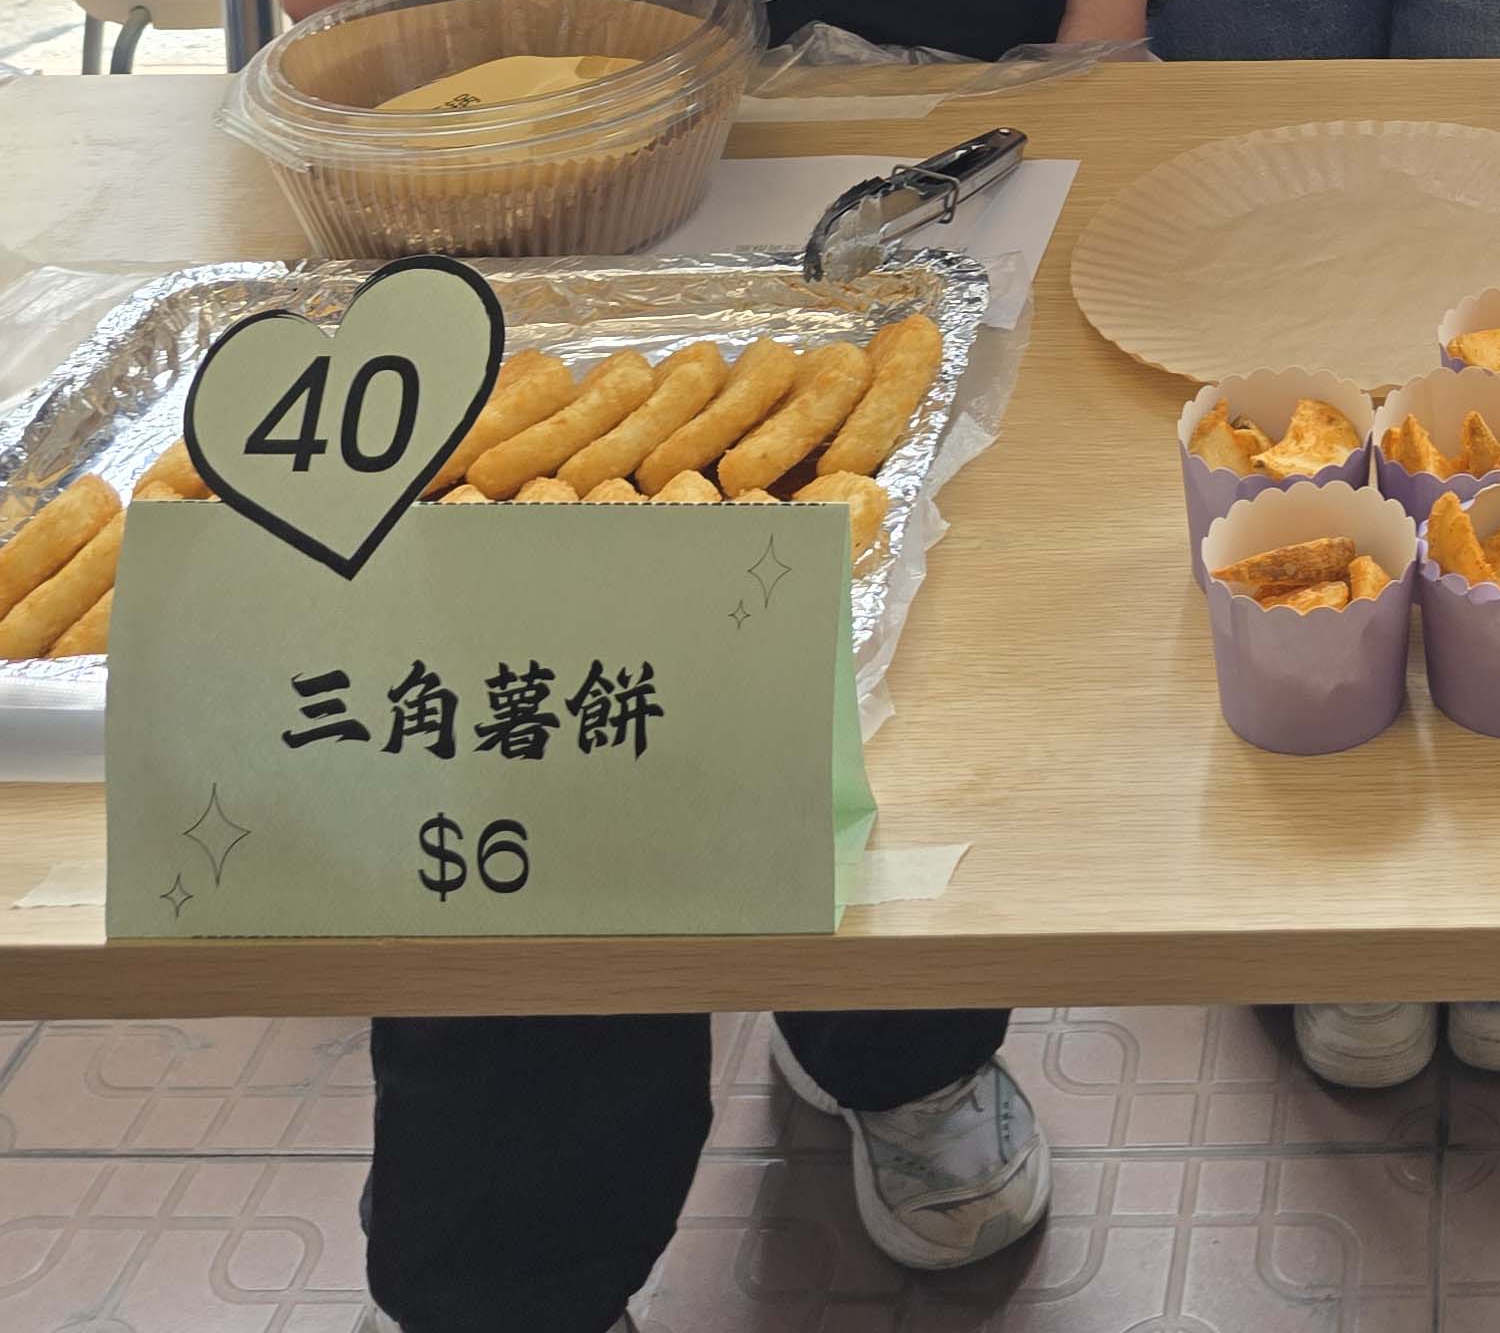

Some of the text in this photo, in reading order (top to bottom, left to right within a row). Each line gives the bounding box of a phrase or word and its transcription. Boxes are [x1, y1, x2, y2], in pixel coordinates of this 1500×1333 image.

[244, 355, 422, 473] 40
[280, 658, 665, 762] 三角薯餅
[416, 811, 532, 903] $6
